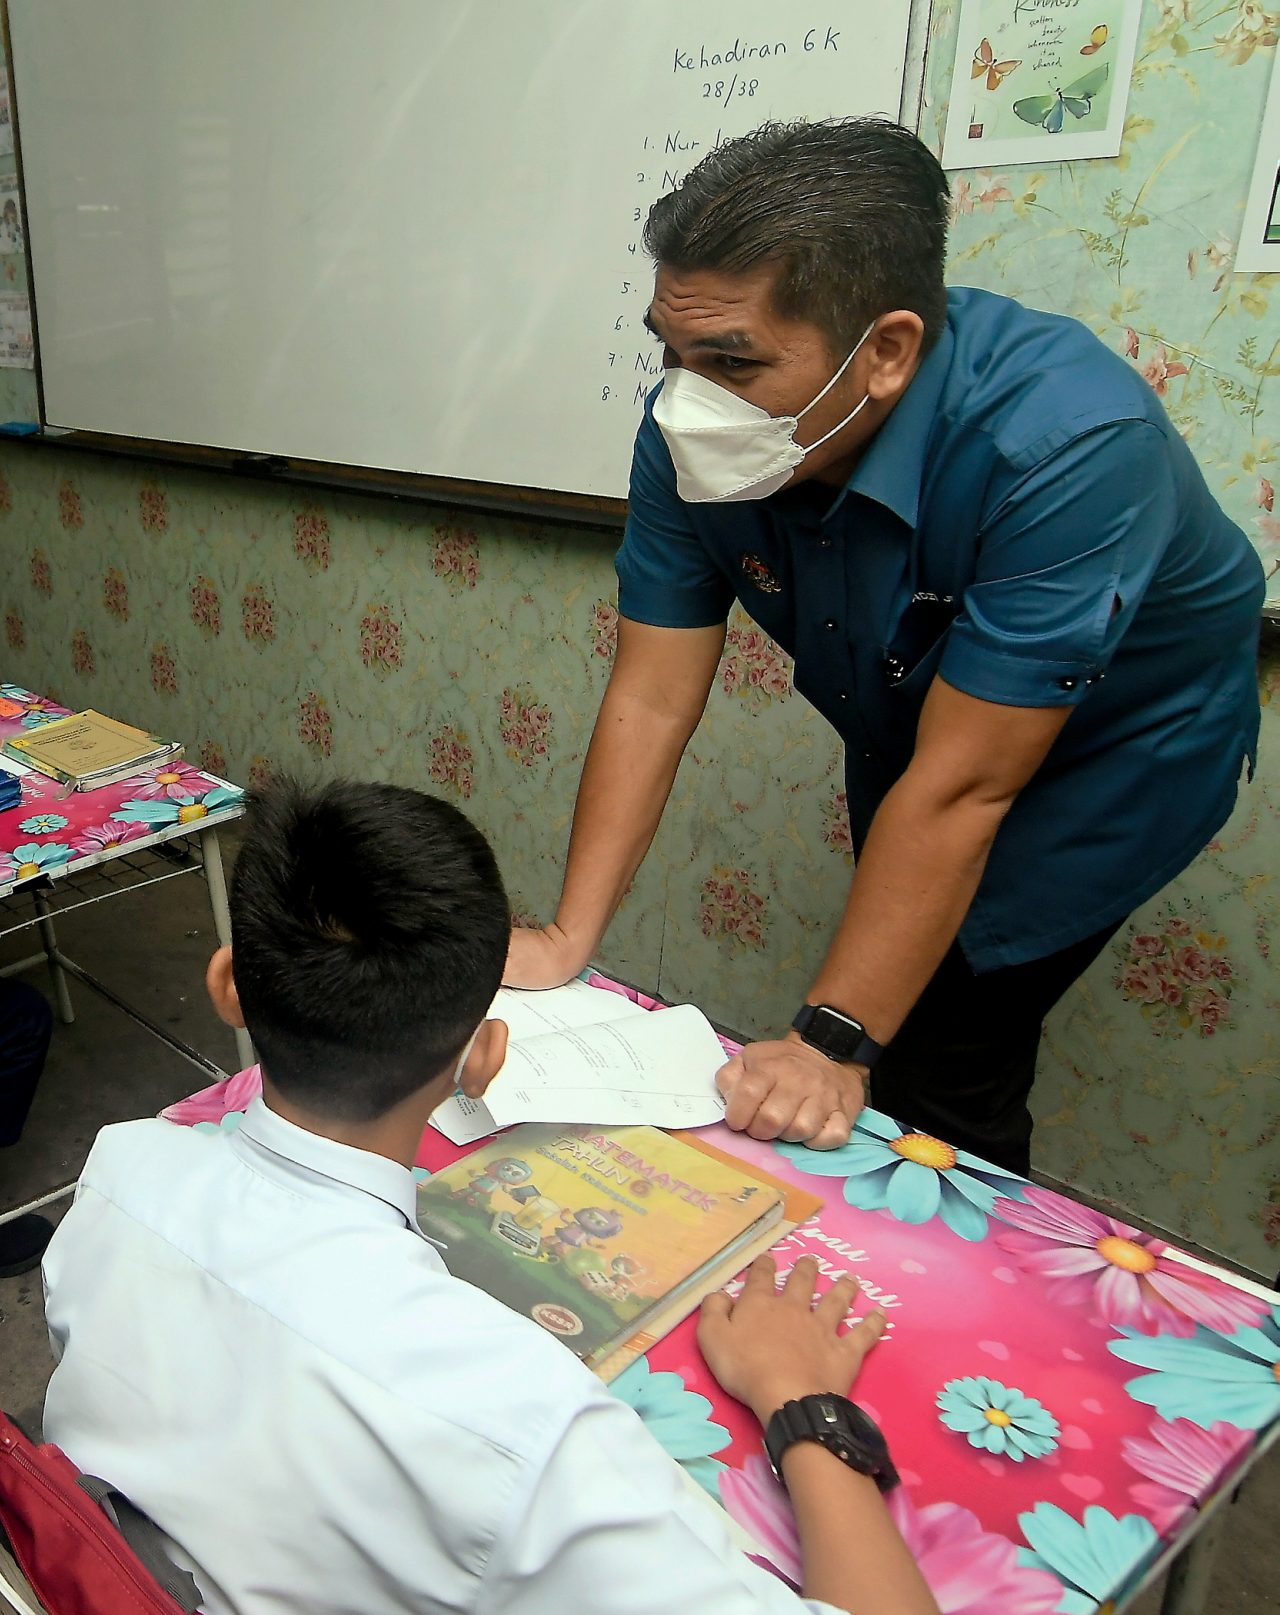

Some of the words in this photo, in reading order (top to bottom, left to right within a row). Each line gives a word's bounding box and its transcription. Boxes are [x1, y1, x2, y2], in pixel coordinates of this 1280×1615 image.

[673, 37, 786, 72] Kehadiran
[702, 74, 759, 108] 28/38
[643, 136, 655, 150] 1.
[664, 130, 700, 154] Nur
[636, 172, 651, 184] 2.
[621, 281, 637, 294] 5.
[614, 315, 629, 331] 6.
[608, 352, 623, 367] 7.
[602, 385, 618, 401] 8.
[551, 1135, 631, 1185] TAHUN
[628, 1178, 652, 1198] 6
[571, 1125, 719, 1213] MATEMATIK
